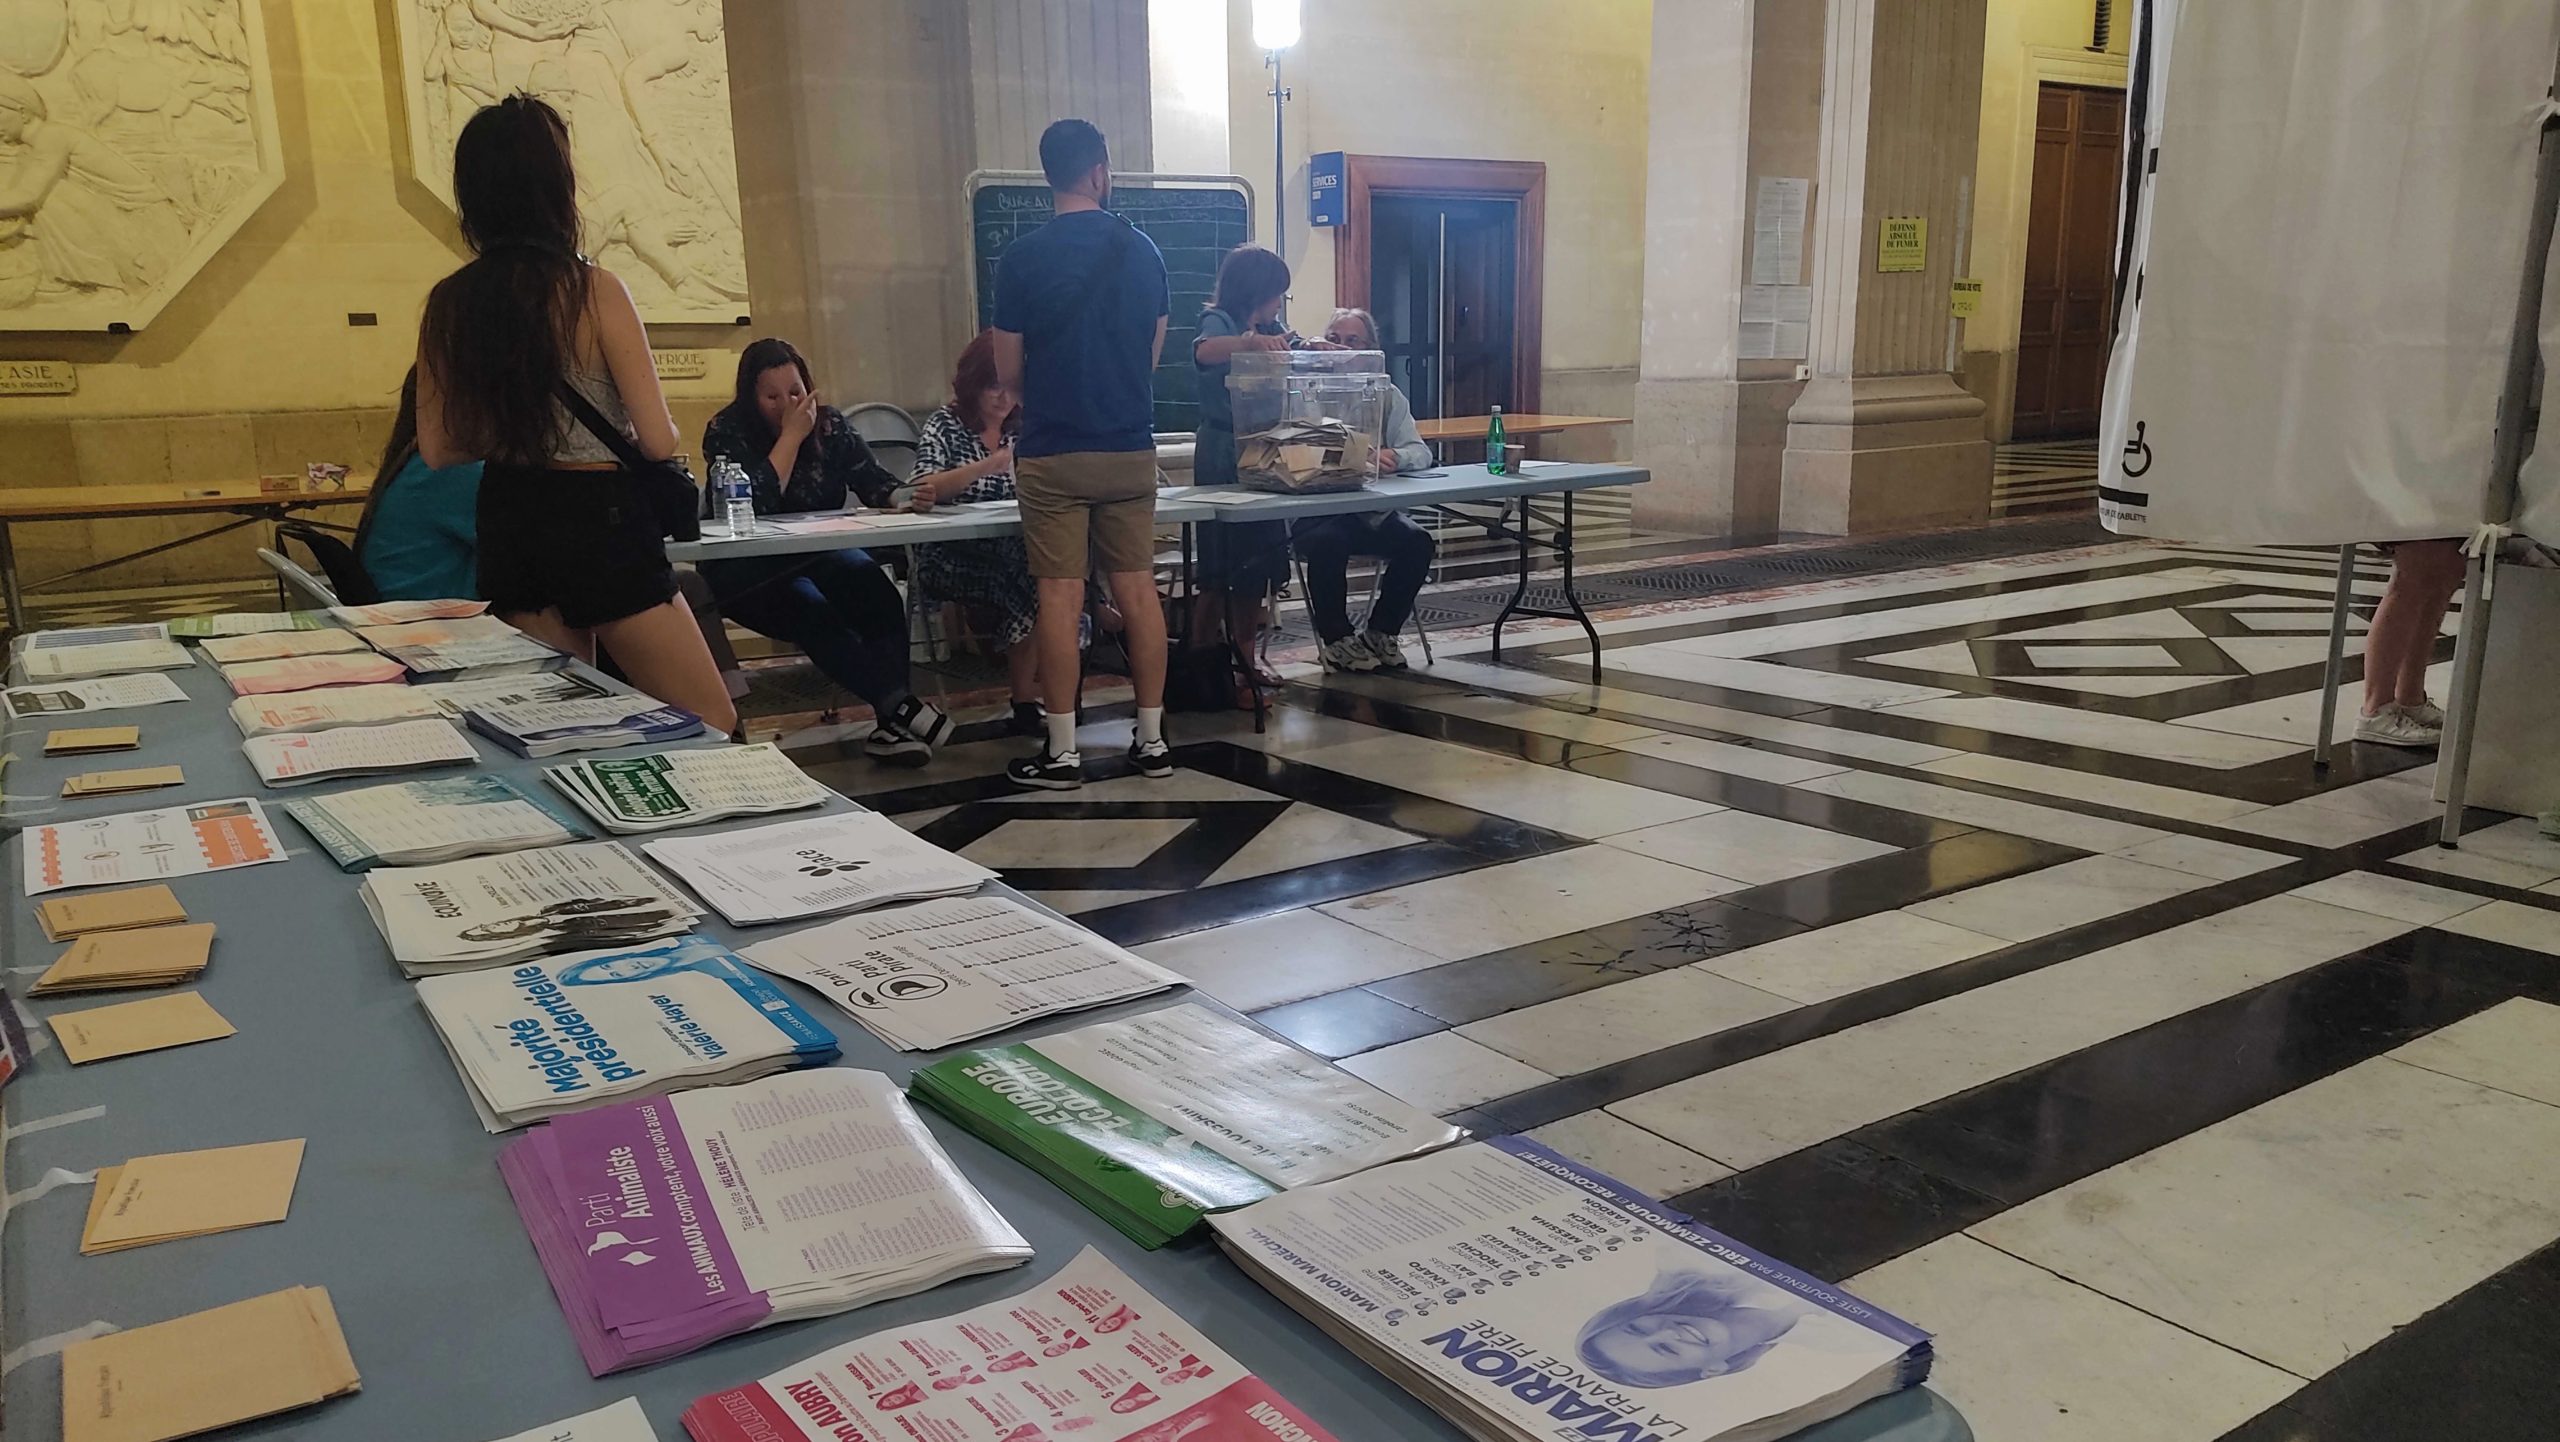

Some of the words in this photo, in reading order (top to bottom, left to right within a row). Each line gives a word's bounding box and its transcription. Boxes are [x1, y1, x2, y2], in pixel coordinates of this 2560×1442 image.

[1312, 174, 1337, 187] SERVICES
[792, 848, 851, 867] pace
[837, 958, 888, 979] Parti
[859, 949, 915, 973] Pirate
[644, 991, 697, 1023] Hayer
[503, 964, 648, 1084] présidentielle
[669, 1021, 731, 1060] Valérie
[493, 1016, 592, 1094] Majorité
[958, 1060, 1076, 1127] EUROPE
[634, 1104, 663, 1128] aussi
[643, 1126, 670, 1147] voix
[702, 1136, 726, 1161] THOUY
[652, 1145, 680, 1171] votre
[600, 1145, 654, 1221] Animaliste
[709, 1160, 738, 1189] HÉLÈNE
[577, 1191, 619, 1227] Parti
[661, 1169, 702, 1224] comptent,
[734, 1205, 750, 1216] de
[1565, 1212, 1610, 1233] GRECH
[1576, 1204, 1627, 1228] Philippe
[1580, 1197, 1634, 1224] VARDON
[1527, 1214, 1584, 1243] MESSIHA
[1557, 1217, 1600, 1237] Sophie
[1621, 1201, 1715, 1246] ZEMMOUR
[678, 1221, 720, 1275] ANIMAUX
[1241, 1227, 1323, 1274] MARÉCHAL
[1480, 1232, 1531, 1259] RIGAULT
[1505, 1225, 1558, 1252] MARION
[1544, 1232, 1574, 1247] Jean
[1444, 1244, 1495, 1272] Laurence
[1455, 1241, 1505, 1268] TROCHU
[1703, 1243, 1753, 1265] ÉRIC
[1407, 1260, 1451, 1286] KNAFO
[1425, 1256, 1468, 1280] Nicolas
[1450, 1261, 1478, 1277] BAY
[1746, 1260, 1775, 1274] PAR
[699, 1272, 727, 1295] Les
[1312, 1272, 1381, 1312] MARION
[1357, 1267, 1413, 1300] Guillaume
[1375, 1267, 1423, 1296] PELTIER
[1403, 1270, 1440, 1290] Sarah
[1769, 1271, 1841, 1304] SOUTENUE
[1082, 1314, 1103, 1324] 11
[1831, 1300, 1873, 1319] LISTE
[1034, 1334, 1055, 1345] 10
[1458, 1318, 1539, 1359] FIÈRE
[924, 1368, 943, 1377] 8
[1151, 1365, 1172, 1374] 6
[865, 1390, 886, 1399] 7
[1097, 1390, 1118, 1399] 5
[1419, 1326, 1664, 1442] MARION
[1531, 1355, 1645, 1415] FRANCE
[783, 1378, 850, 1428] AUBRY
[1047, 1410, 1067, 1418] 4
[991, 1427, 1012, 1436] 3
[1640, 1412, 1688, 1437] LA
